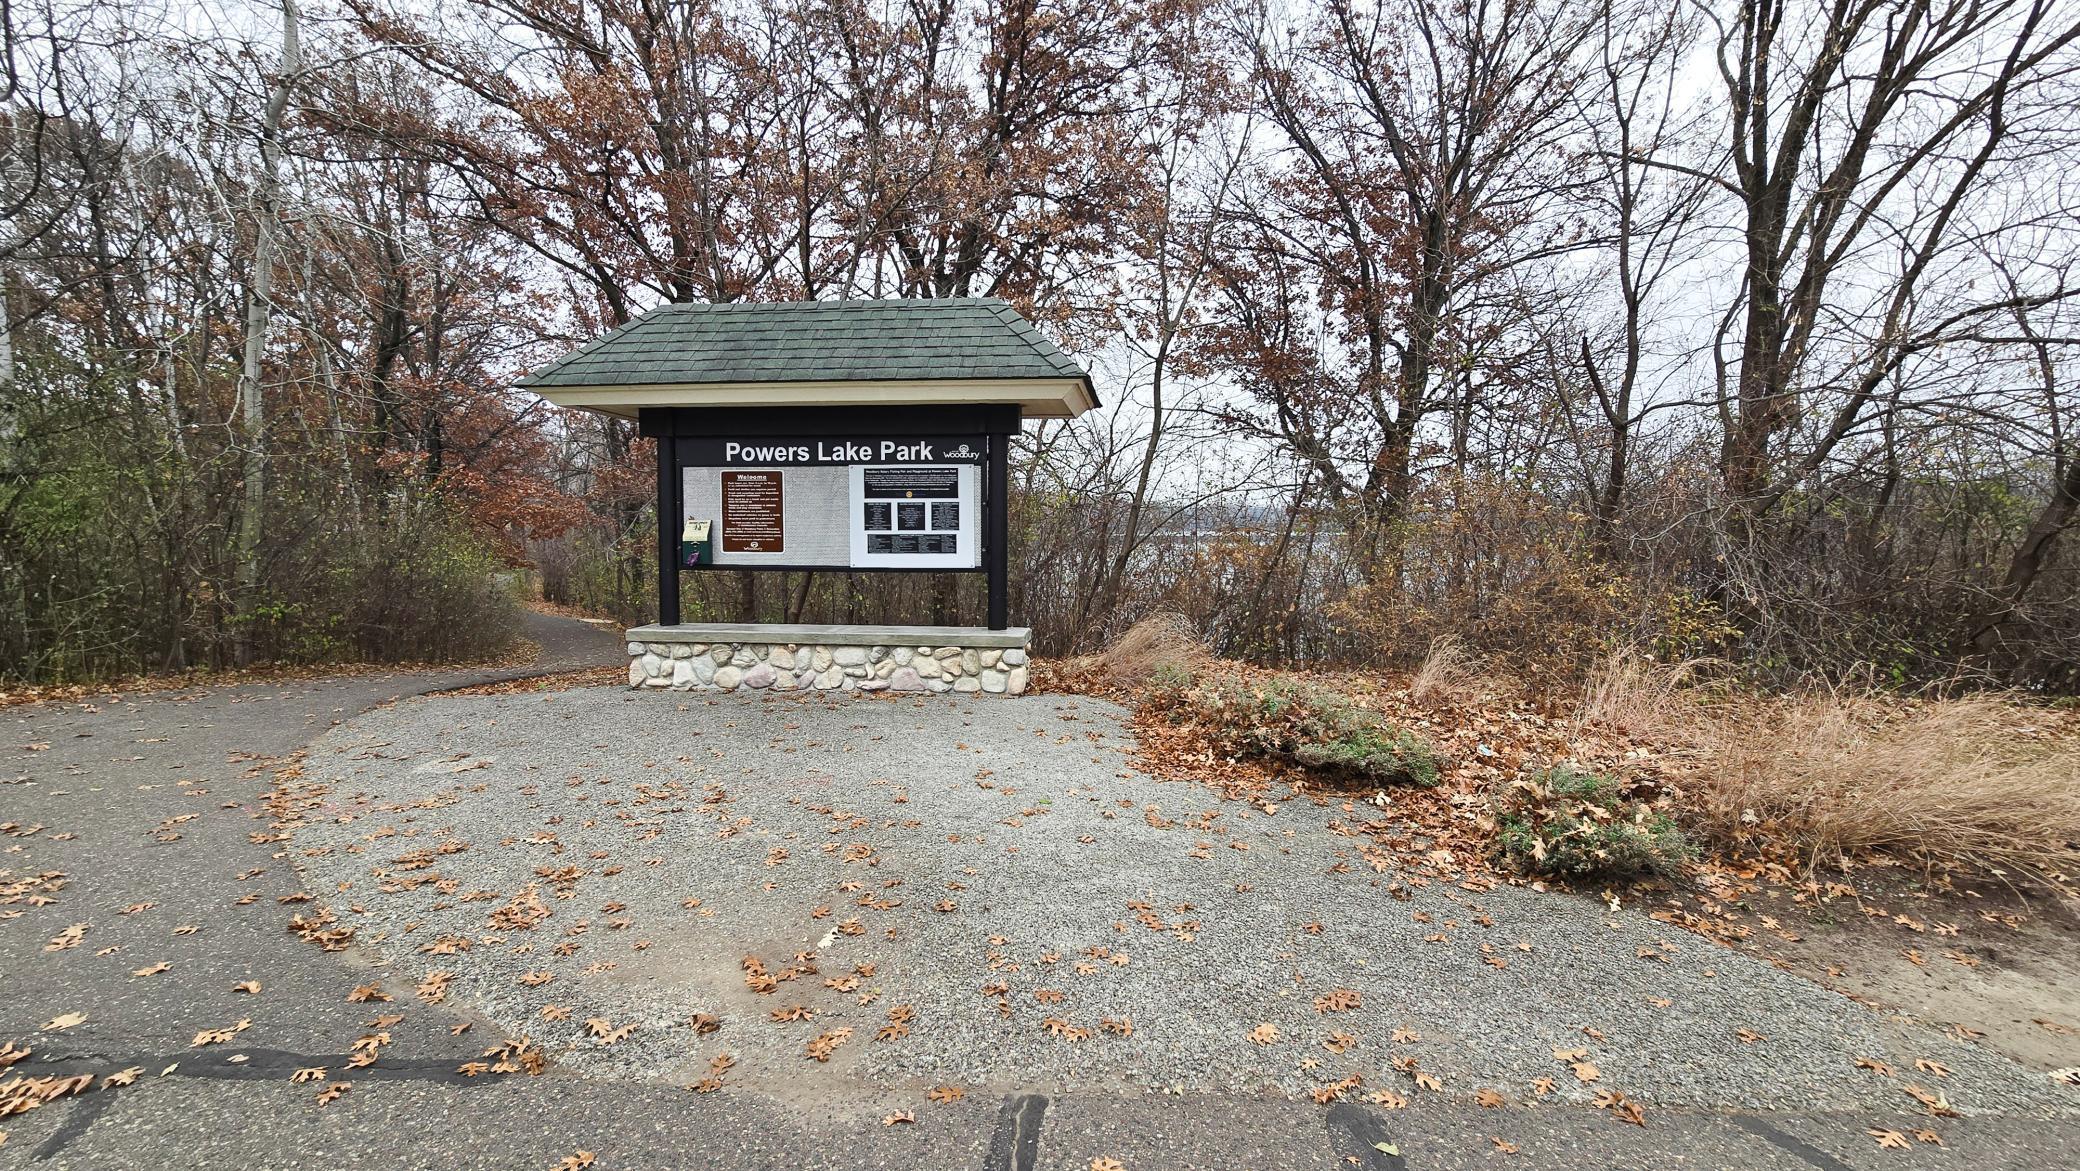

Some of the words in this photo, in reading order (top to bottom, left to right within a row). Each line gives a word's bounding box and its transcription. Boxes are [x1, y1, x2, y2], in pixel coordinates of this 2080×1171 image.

[726, 442, 810, 462] Powers
[817, 441, 873, 461] Lake
[880, 440, 934, 461] Park
[943, 451, 980, 460] Woodbury
